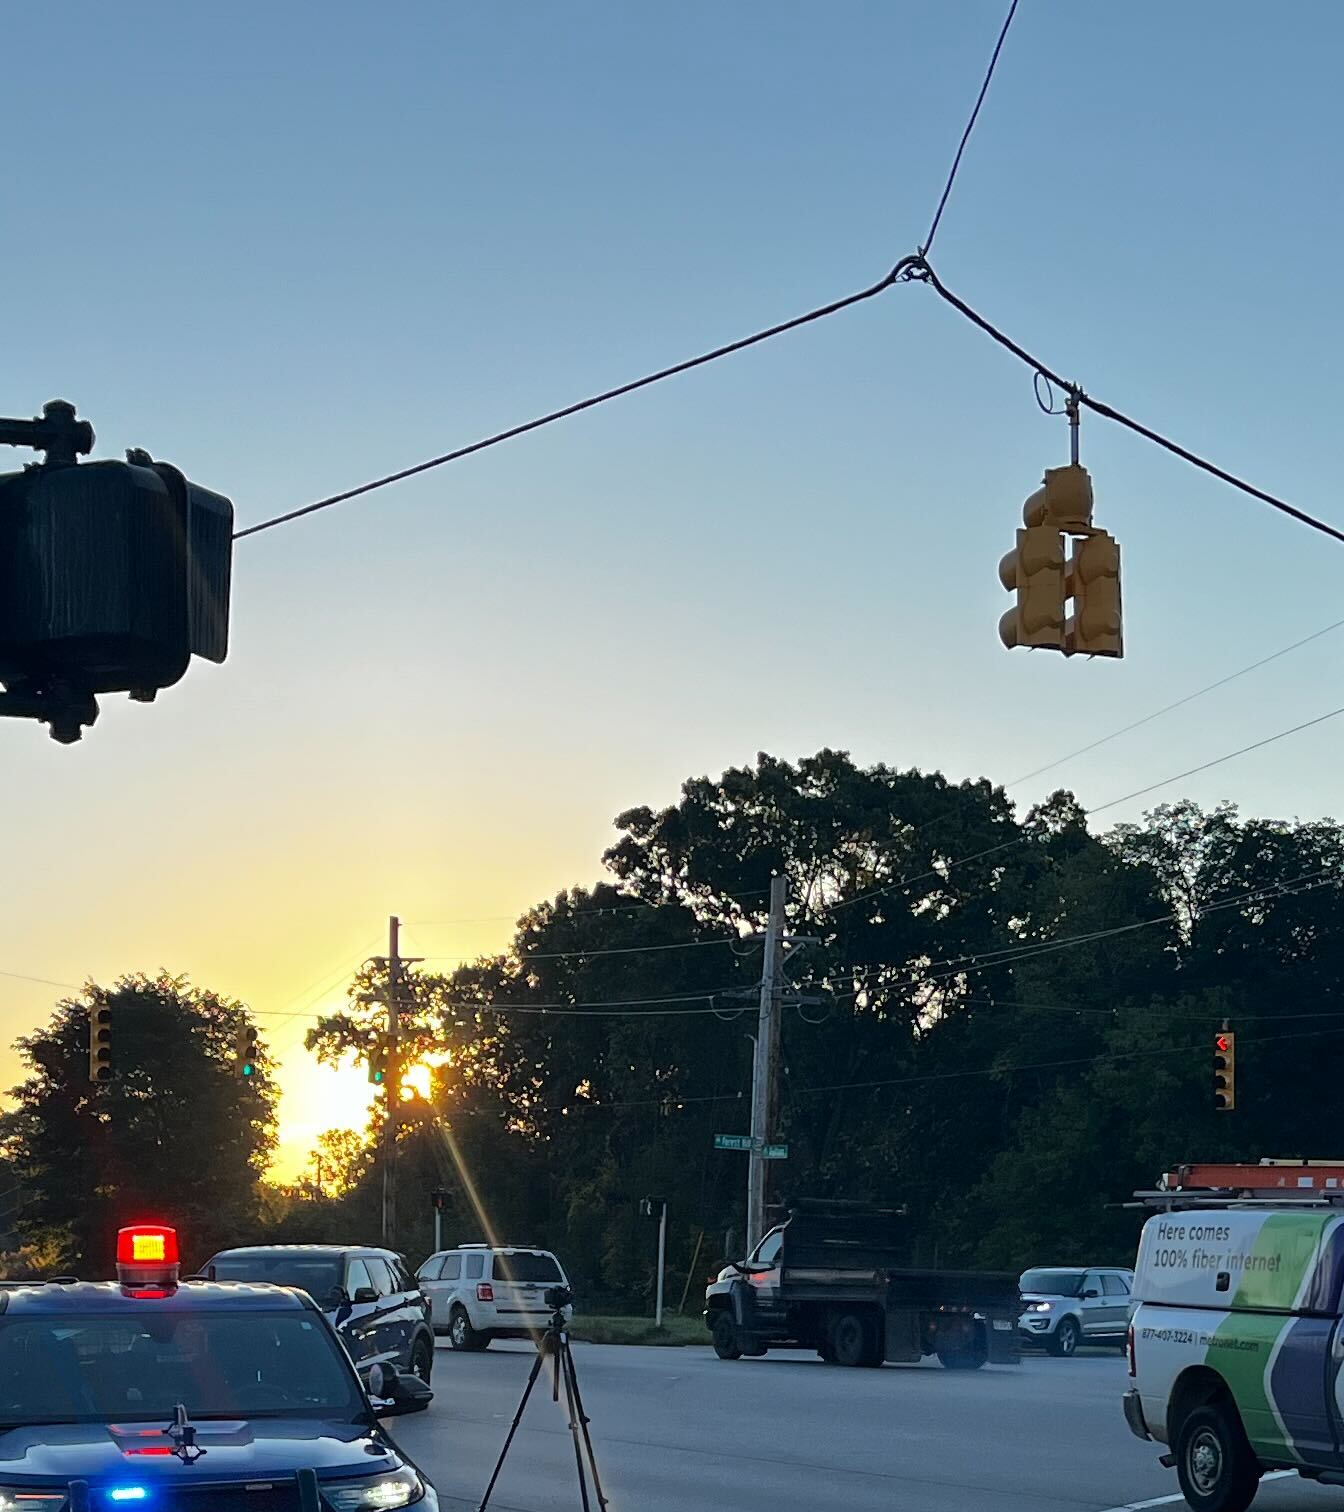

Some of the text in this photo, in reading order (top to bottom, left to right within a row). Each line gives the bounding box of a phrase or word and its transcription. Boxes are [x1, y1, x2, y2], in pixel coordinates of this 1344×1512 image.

[1158, 1222, 1230, 1241] Here comes
[1154, 1248, 1281, 1272] 100% fiber internet
